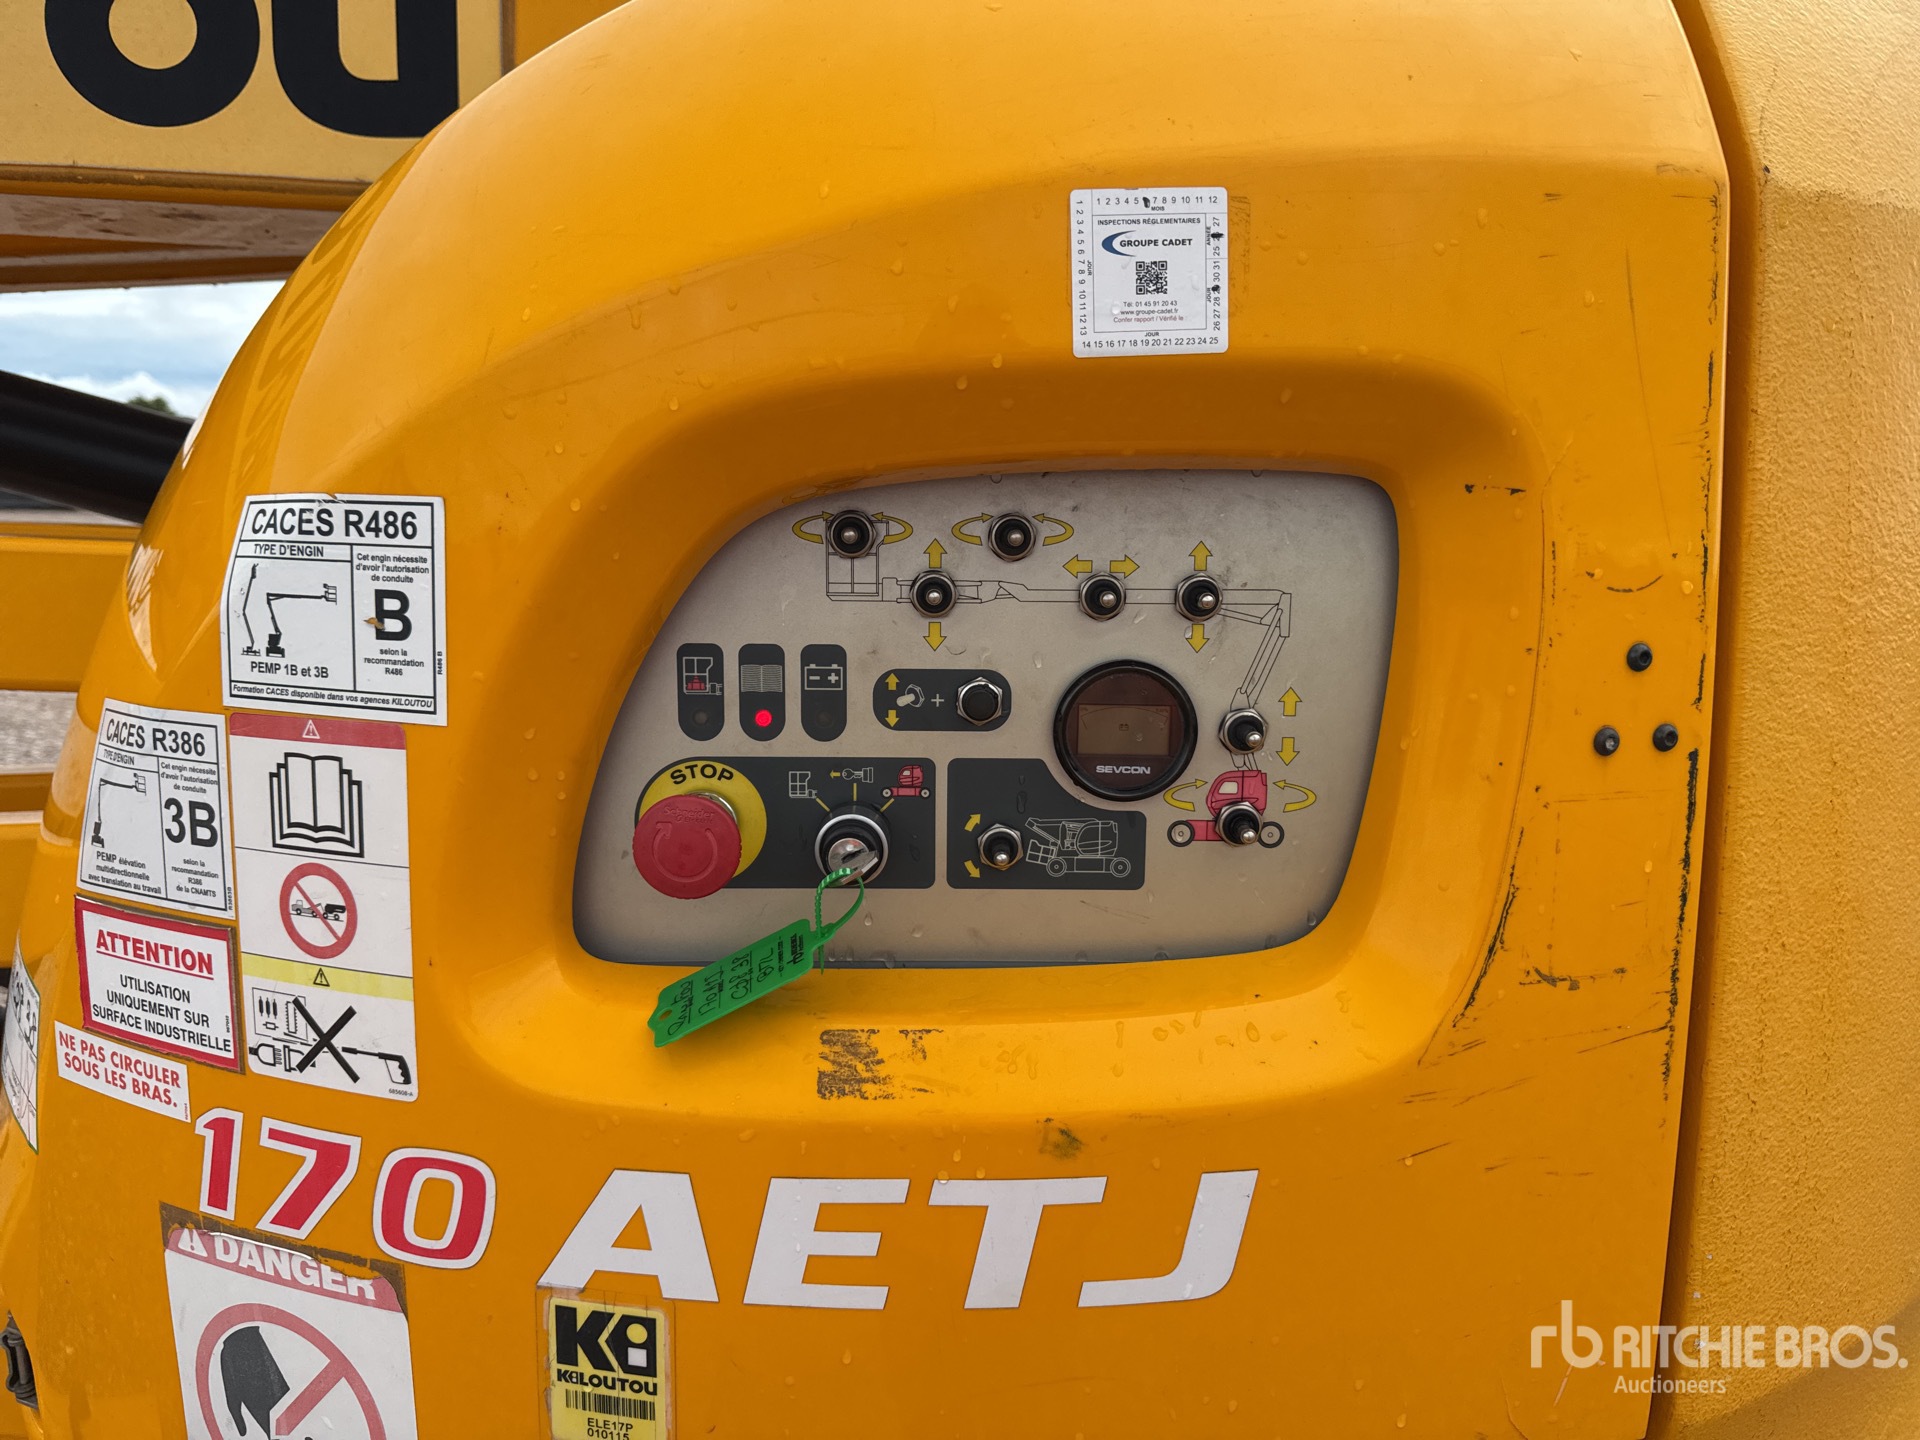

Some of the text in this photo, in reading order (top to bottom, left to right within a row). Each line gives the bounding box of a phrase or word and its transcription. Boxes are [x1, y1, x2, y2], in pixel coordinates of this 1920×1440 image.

[1181, 196, 1191, 204] 10
[1195, 196, 1203, 204] 11
[1208, 196, 1218, 204] 12
[1098, 217, 1200, 226] INSPECTIONS RÉGLEMENTAIRES
[1213, 217, 1220, 226] 27
[1120, 238, 1193, 247] GROUPE CADET
[1213, 246, 1220, 256] 25
[1213, 260, 1220, 270] 31
[1213, 272, 1220, 282] 30
[1079, 290, 1086, 299] 10
[1079, 302, 1086, 310] 11
[1213, 296, 1220, 307] 28
[1080, 314, 1087, 324] 12
[1213, 309, 1220, 318] 27
[1080, 326, 1087, 336] 13
[1213, 321, 1220, 331] 26
[1082, 341, 1091, 349] 14
[1197, 337, 1207, 345] 24
[252, 508, 417, 540] CACES R486
[254, 544, 324, 557] TYPE D'ENGIN
[371, 554, 391, 563] engin
[393, 555, 428, 564] nécessite
[382, 565, 429, 574] l'autorisation
[371, 574, 413, 583] de conduite
[375, 588, 412, 641] B
[380, 648, 399, 656] selon
[364, 657, 424, 667] recommandation
[250, 661, 329, 678] PEMP 1B et 3B
[385, 668, 403, 676] R486
[233, 684, 264, 695] Formation
[266, 687, 290, 696] CACES
[291, 689, 325, 700] disponible
[327, 692, 344, 701] dans
[360, 696, 390, 705] agences
[392, 698, 433, 708] KILOUTOU
[106, 718, 205, 756] CACES R386
[161, 762, 216, 775] Cet engin nécessite
[670, 763, 734, 785] STOP
[1096, 765, 1150, 774] SEVCON
[161, 772, 218, 786] d'avoir l'autorisation
[182, 785, 207, 794] conduite
[664, 806, 715, 818] Schneider
[164, 797, 218, 848] 3B
[96, 851, 146, 869] PEMP élévation
[183, 858, 198, 866] selon
[96, 864, 150, 881] multidirectionnelle
[172, 866, 219, 879] recommandation
[88, 873, 100, 882] avec
[101, 875, 132, 889] translation
[142, 884, 162, 894] travail
[191, 888, 216, 898] CNAMTS
[96, 929, 213, 976] ATTENTION
[120, 974, 191, 1004] UTILISATION
[106, 989, 180, 1021] UNIQUEMENT
[184, 1010, 210, 1028] SUR
[93, 1004, 142, 1029] SURFACE
[145, 1019, 232, 1053] INDUSTRIELLE
[59, 1031, 181, 1089] NE PAS CIRCULER
[65, 1052, 178, 1108] SOUS LES BRAS.
[195, 1107, 1260, 1309] 170 AETJ
[214, 1235, 376, 1300] DANGER
[587, 1417, 633, 1432] ELE17P
[587, 1428, 630, 1440] 010115
